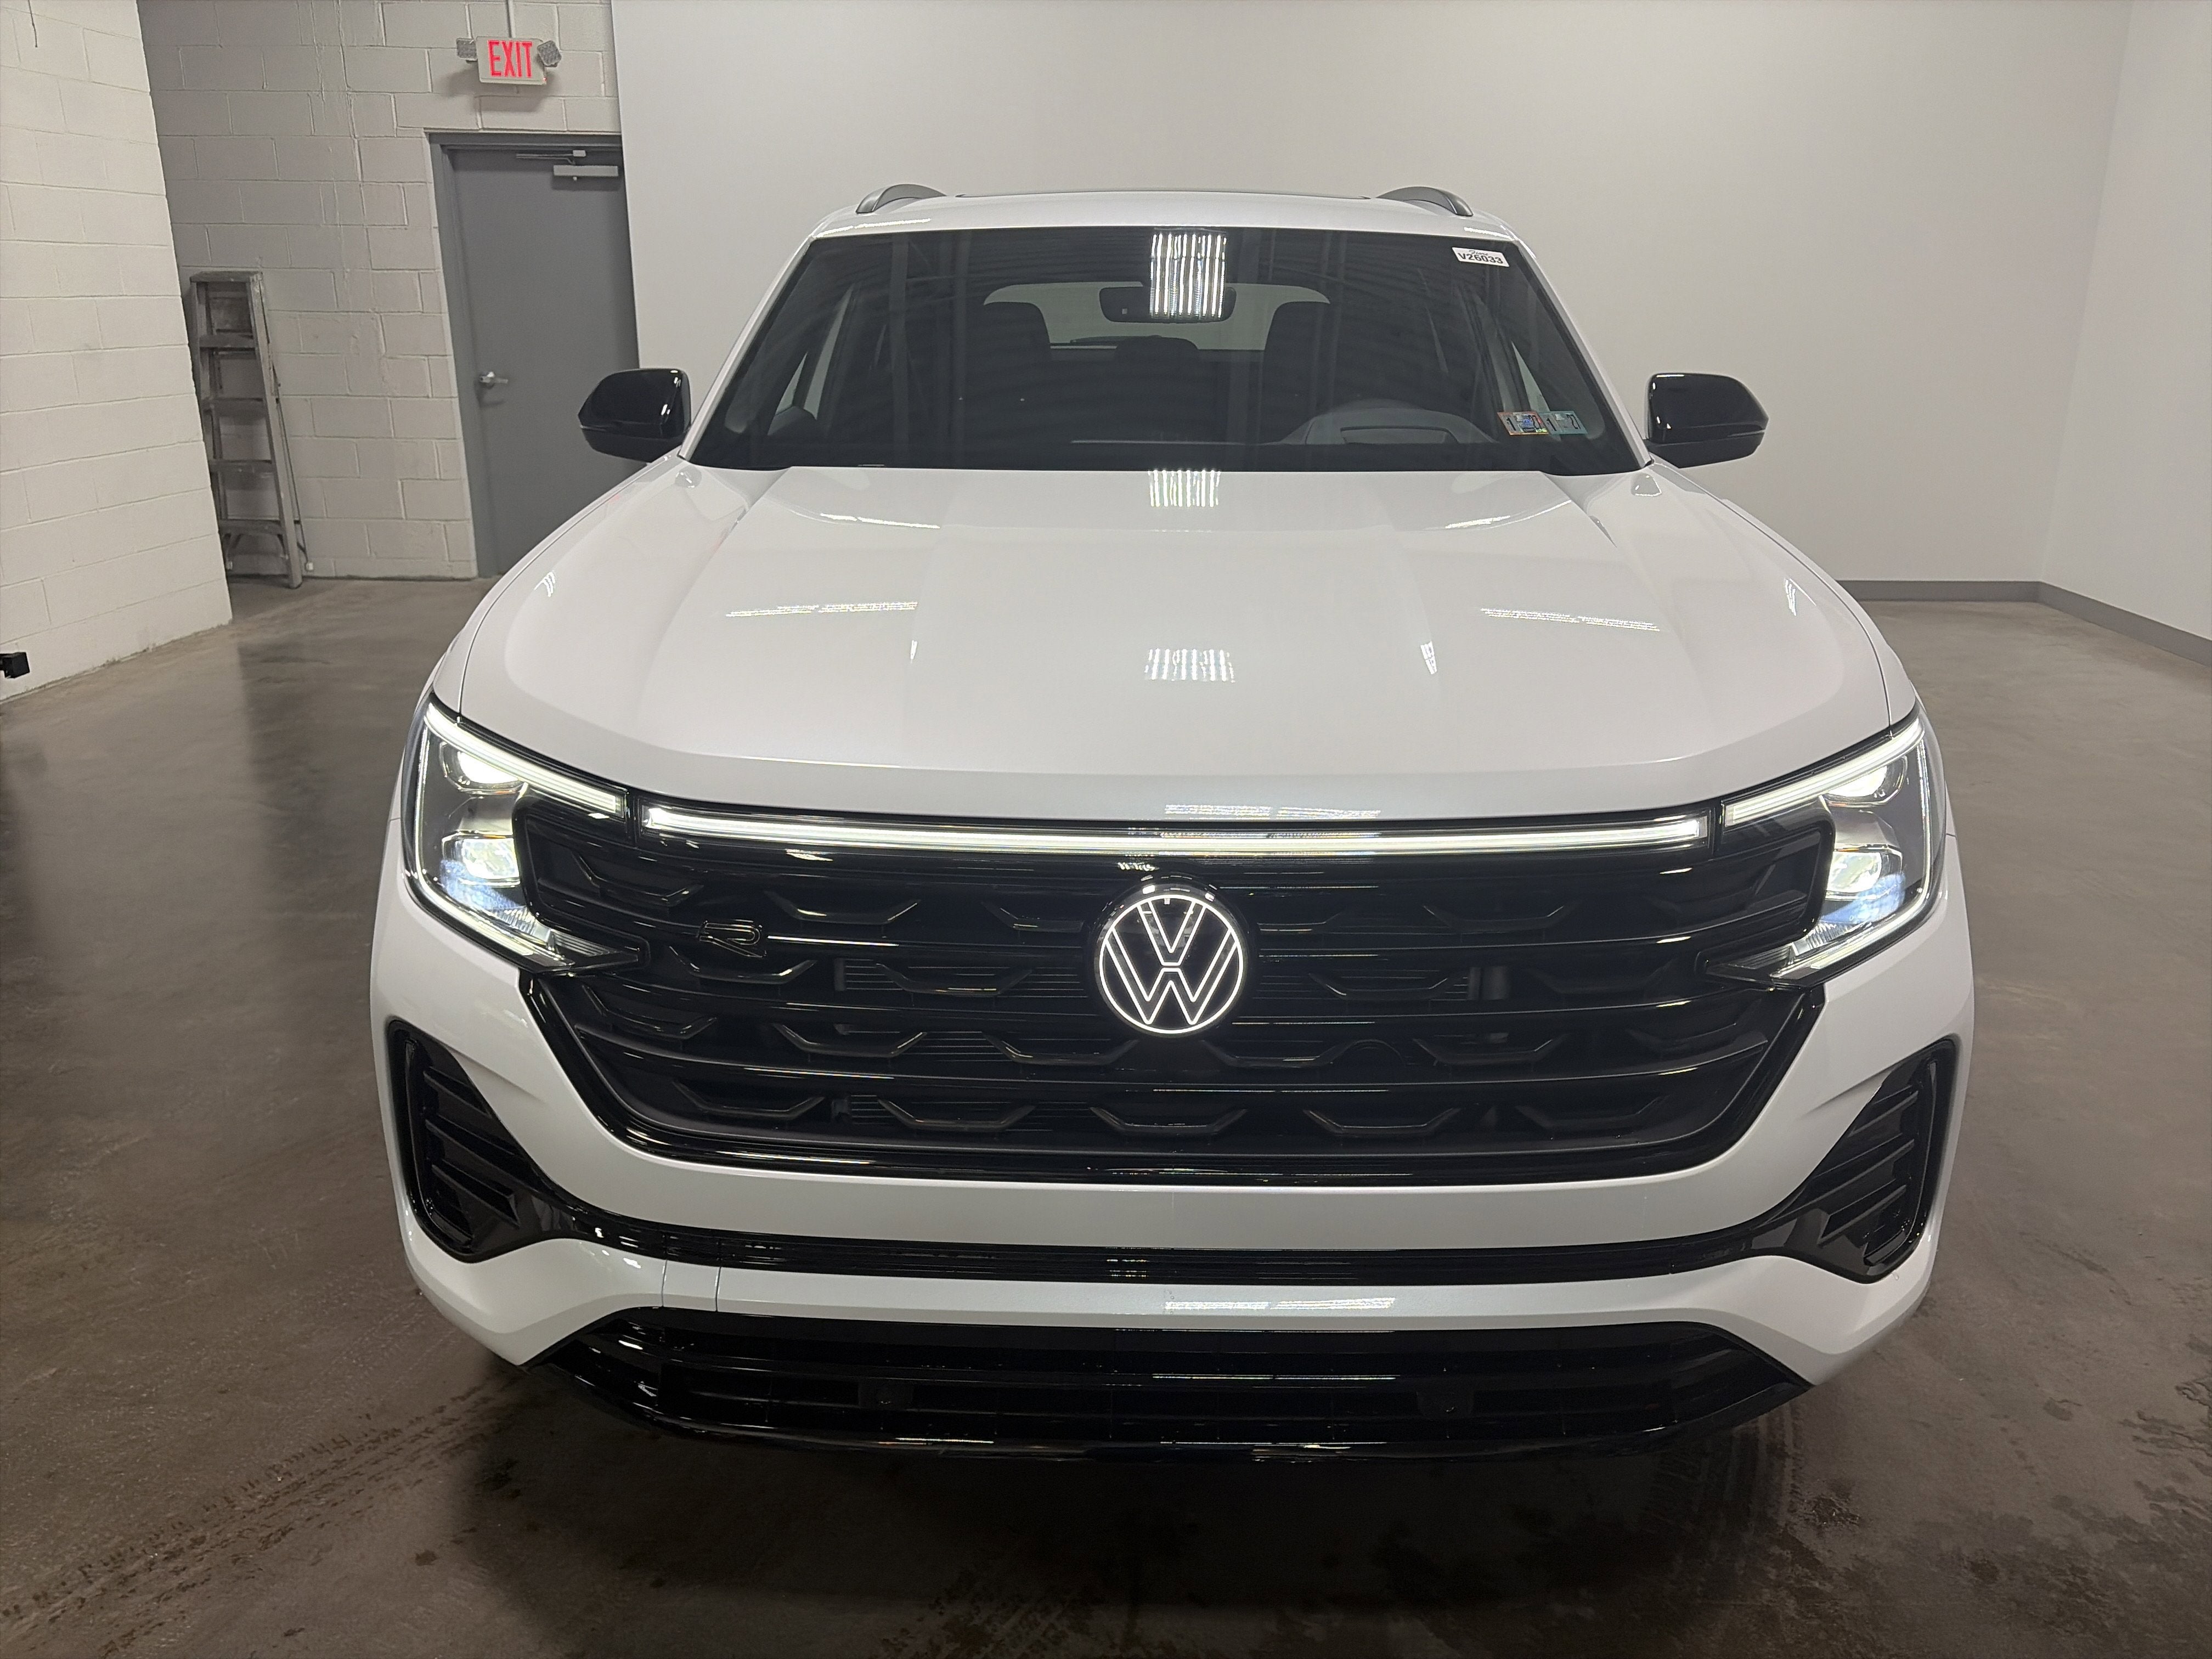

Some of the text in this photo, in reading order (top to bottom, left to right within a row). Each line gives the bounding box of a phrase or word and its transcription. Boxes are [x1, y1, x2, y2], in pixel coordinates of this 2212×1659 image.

[487, 40, 533, 78] EXIT
[1458, 252, 1503, 264] V26033
[1547, 417, 1557, 432] 1
[1104, 900, 1239, 1025] VW
